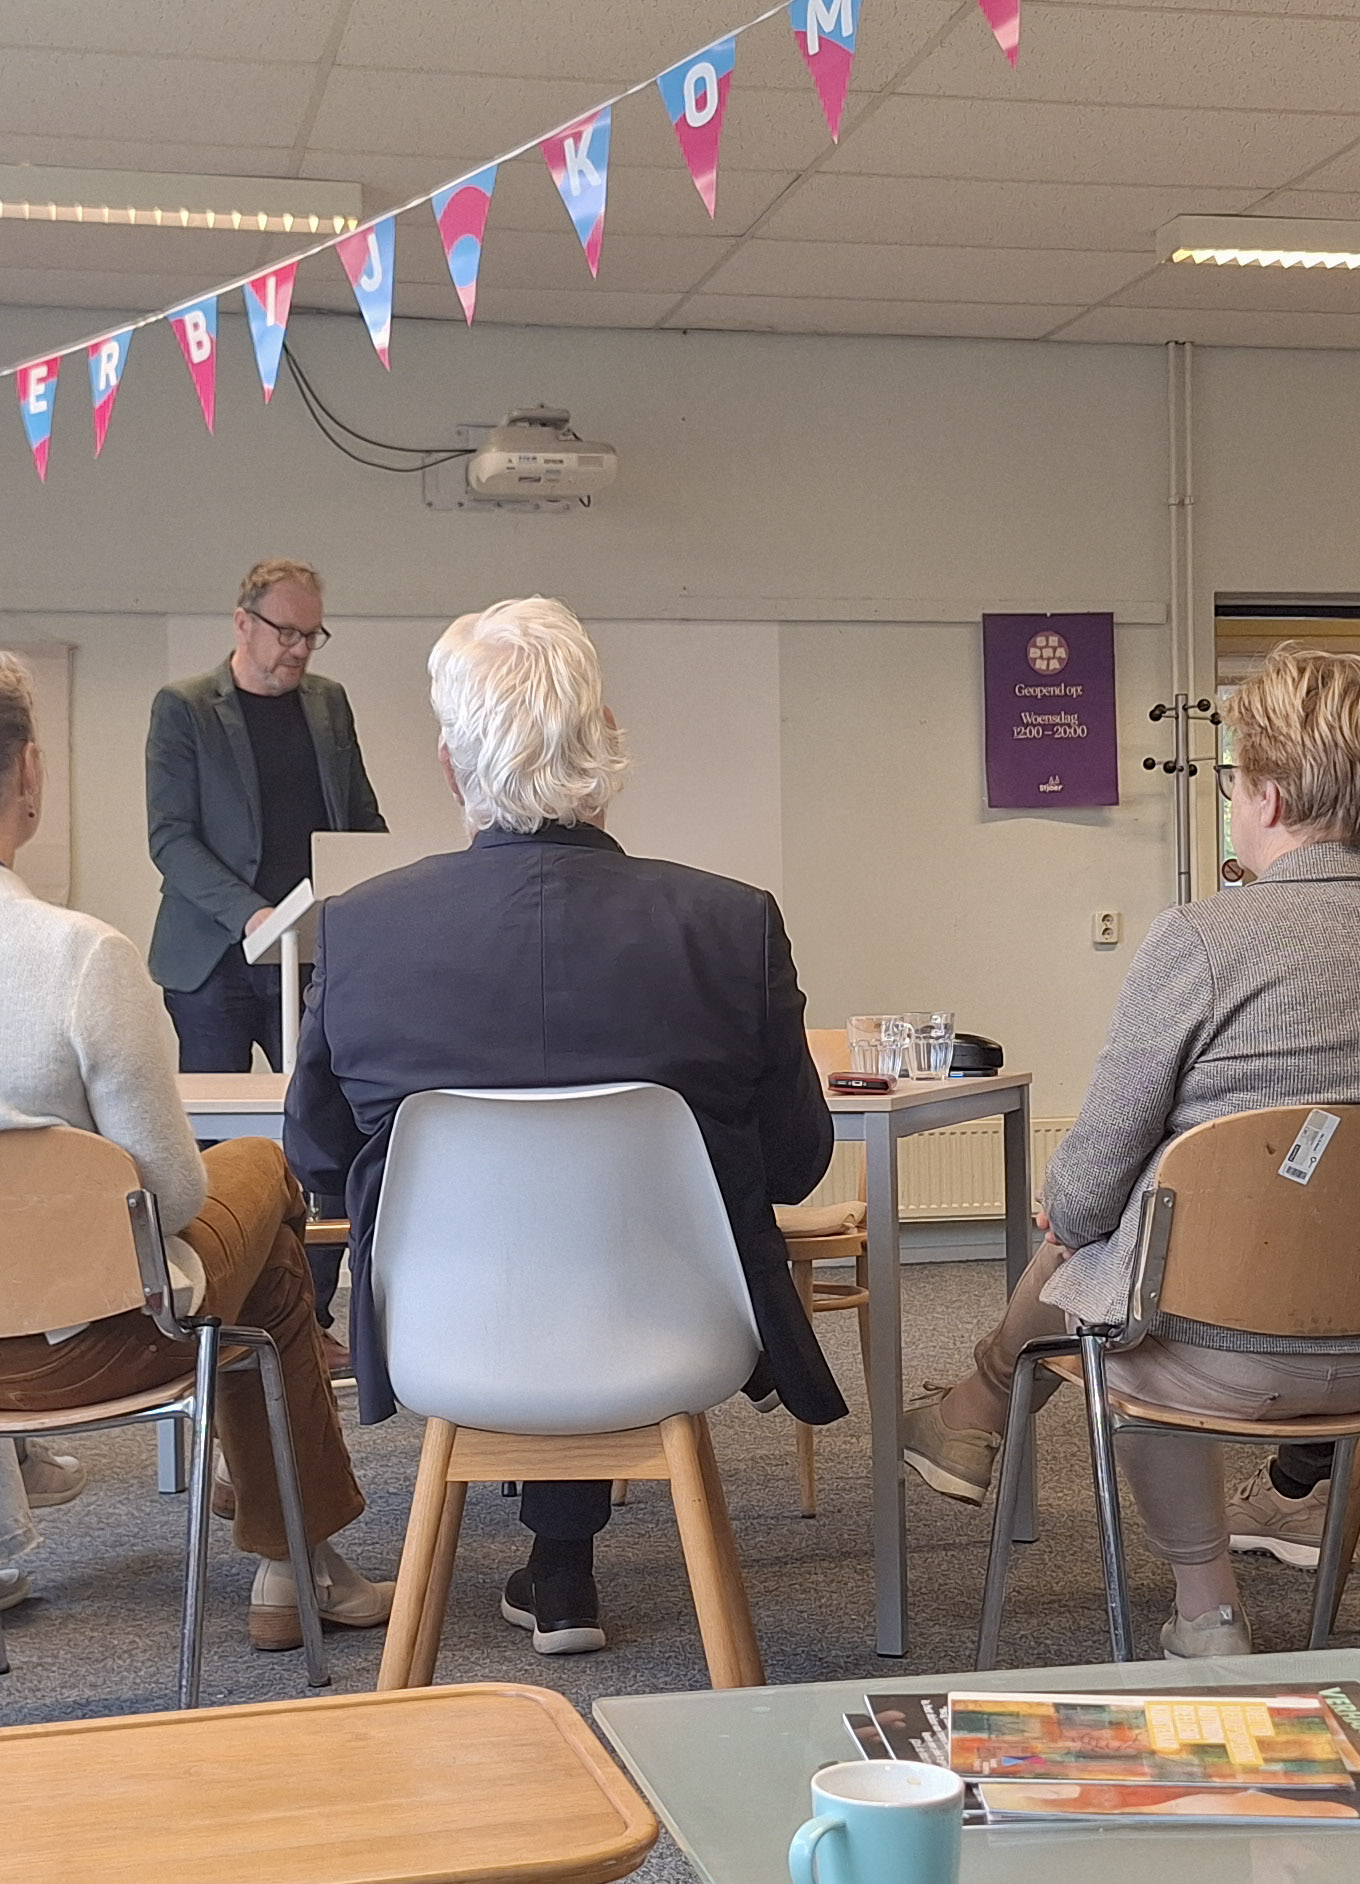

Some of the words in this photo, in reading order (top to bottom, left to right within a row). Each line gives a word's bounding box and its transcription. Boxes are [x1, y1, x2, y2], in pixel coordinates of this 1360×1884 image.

[1015, 682, 1065, 699] Geopend
[1066, 685, 1083, 698] op:
[1020, 711, 1078, 727] Woensdag
[1012, 725, 1043, 739] 12:00
[1053, 725, 1088, 738] 20:00
